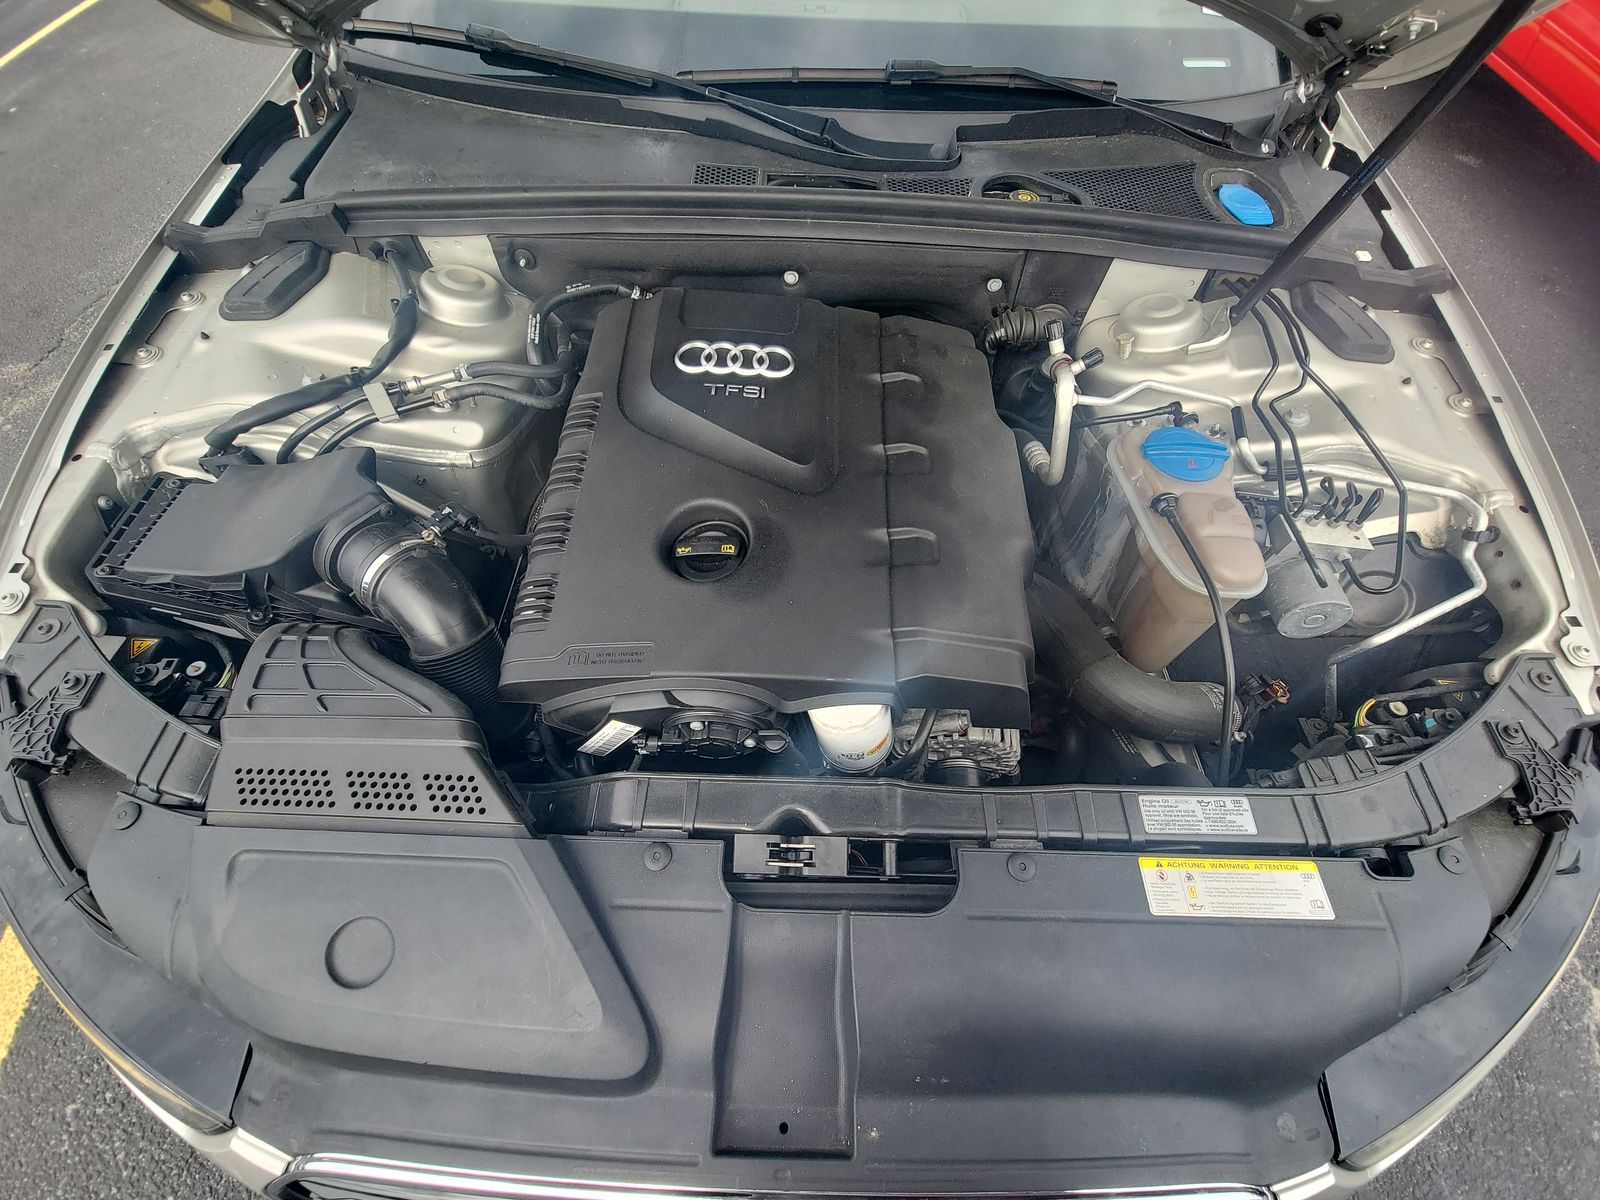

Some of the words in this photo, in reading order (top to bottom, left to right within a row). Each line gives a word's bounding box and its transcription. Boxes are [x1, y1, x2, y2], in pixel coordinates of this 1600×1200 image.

[703, 383, 765, 399] TFSI
[1167, 861, 1206, 869] ACHTUNG
[1208, 862, 1250, 870] WARNING
[1254, 863, 1299, 871] ATTENTION
